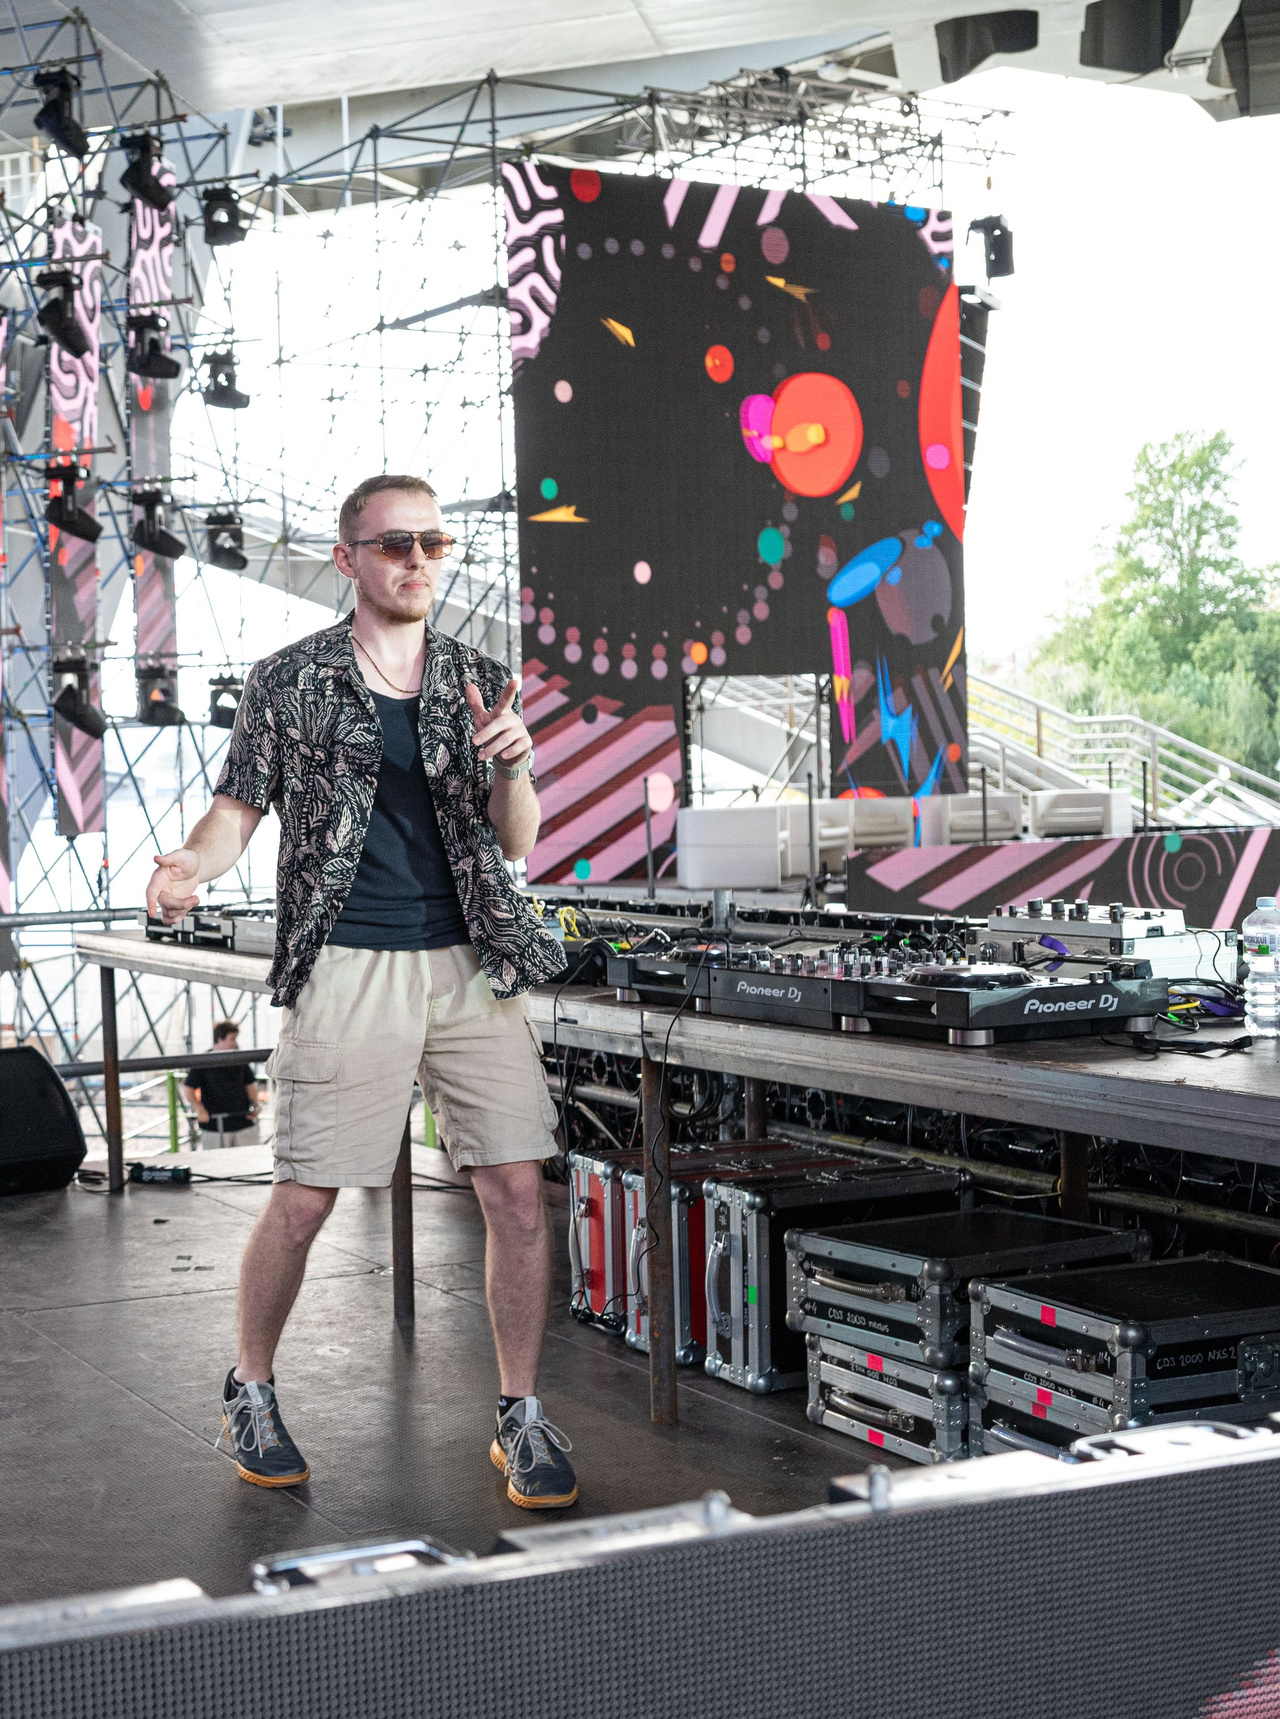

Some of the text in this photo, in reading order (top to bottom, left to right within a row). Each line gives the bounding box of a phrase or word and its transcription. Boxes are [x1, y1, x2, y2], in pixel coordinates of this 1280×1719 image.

[736, 980, 786, 997] Pioneer
[1023, 998, 1096, 1015] Pioneer
[1156, 1357, 1176, 1370] CDJ
[1179, 1353, 1204, 1366] 2000
